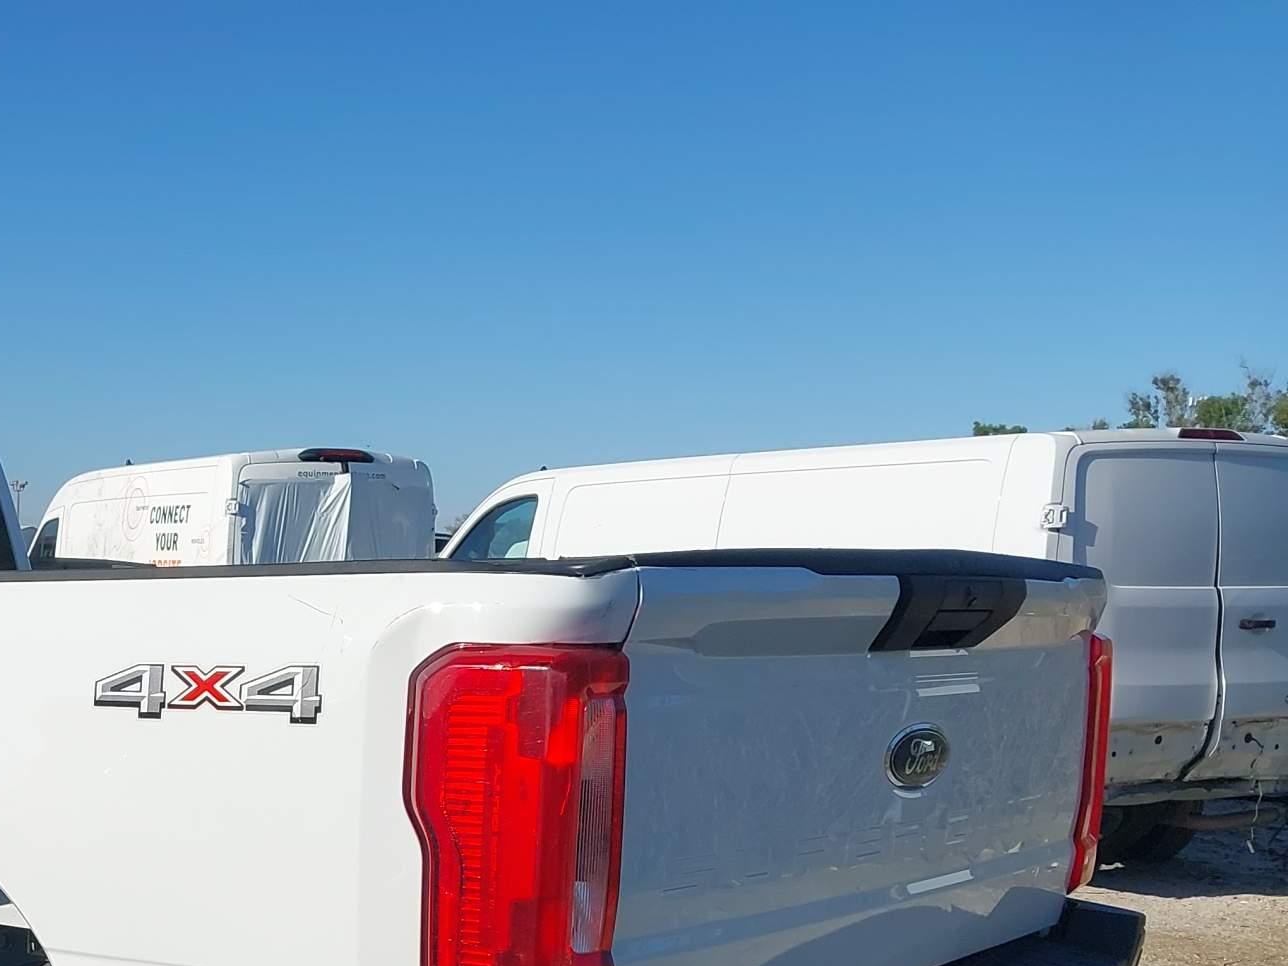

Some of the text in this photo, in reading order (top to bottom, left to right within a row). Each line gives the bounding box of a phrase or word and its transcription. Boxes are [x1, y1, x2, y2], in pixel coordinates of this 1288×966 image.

[149, 504, 192, 525] CONNECT
[155, 532, 179, 552] YOUR
[904, 737, 943, 775] Ford
